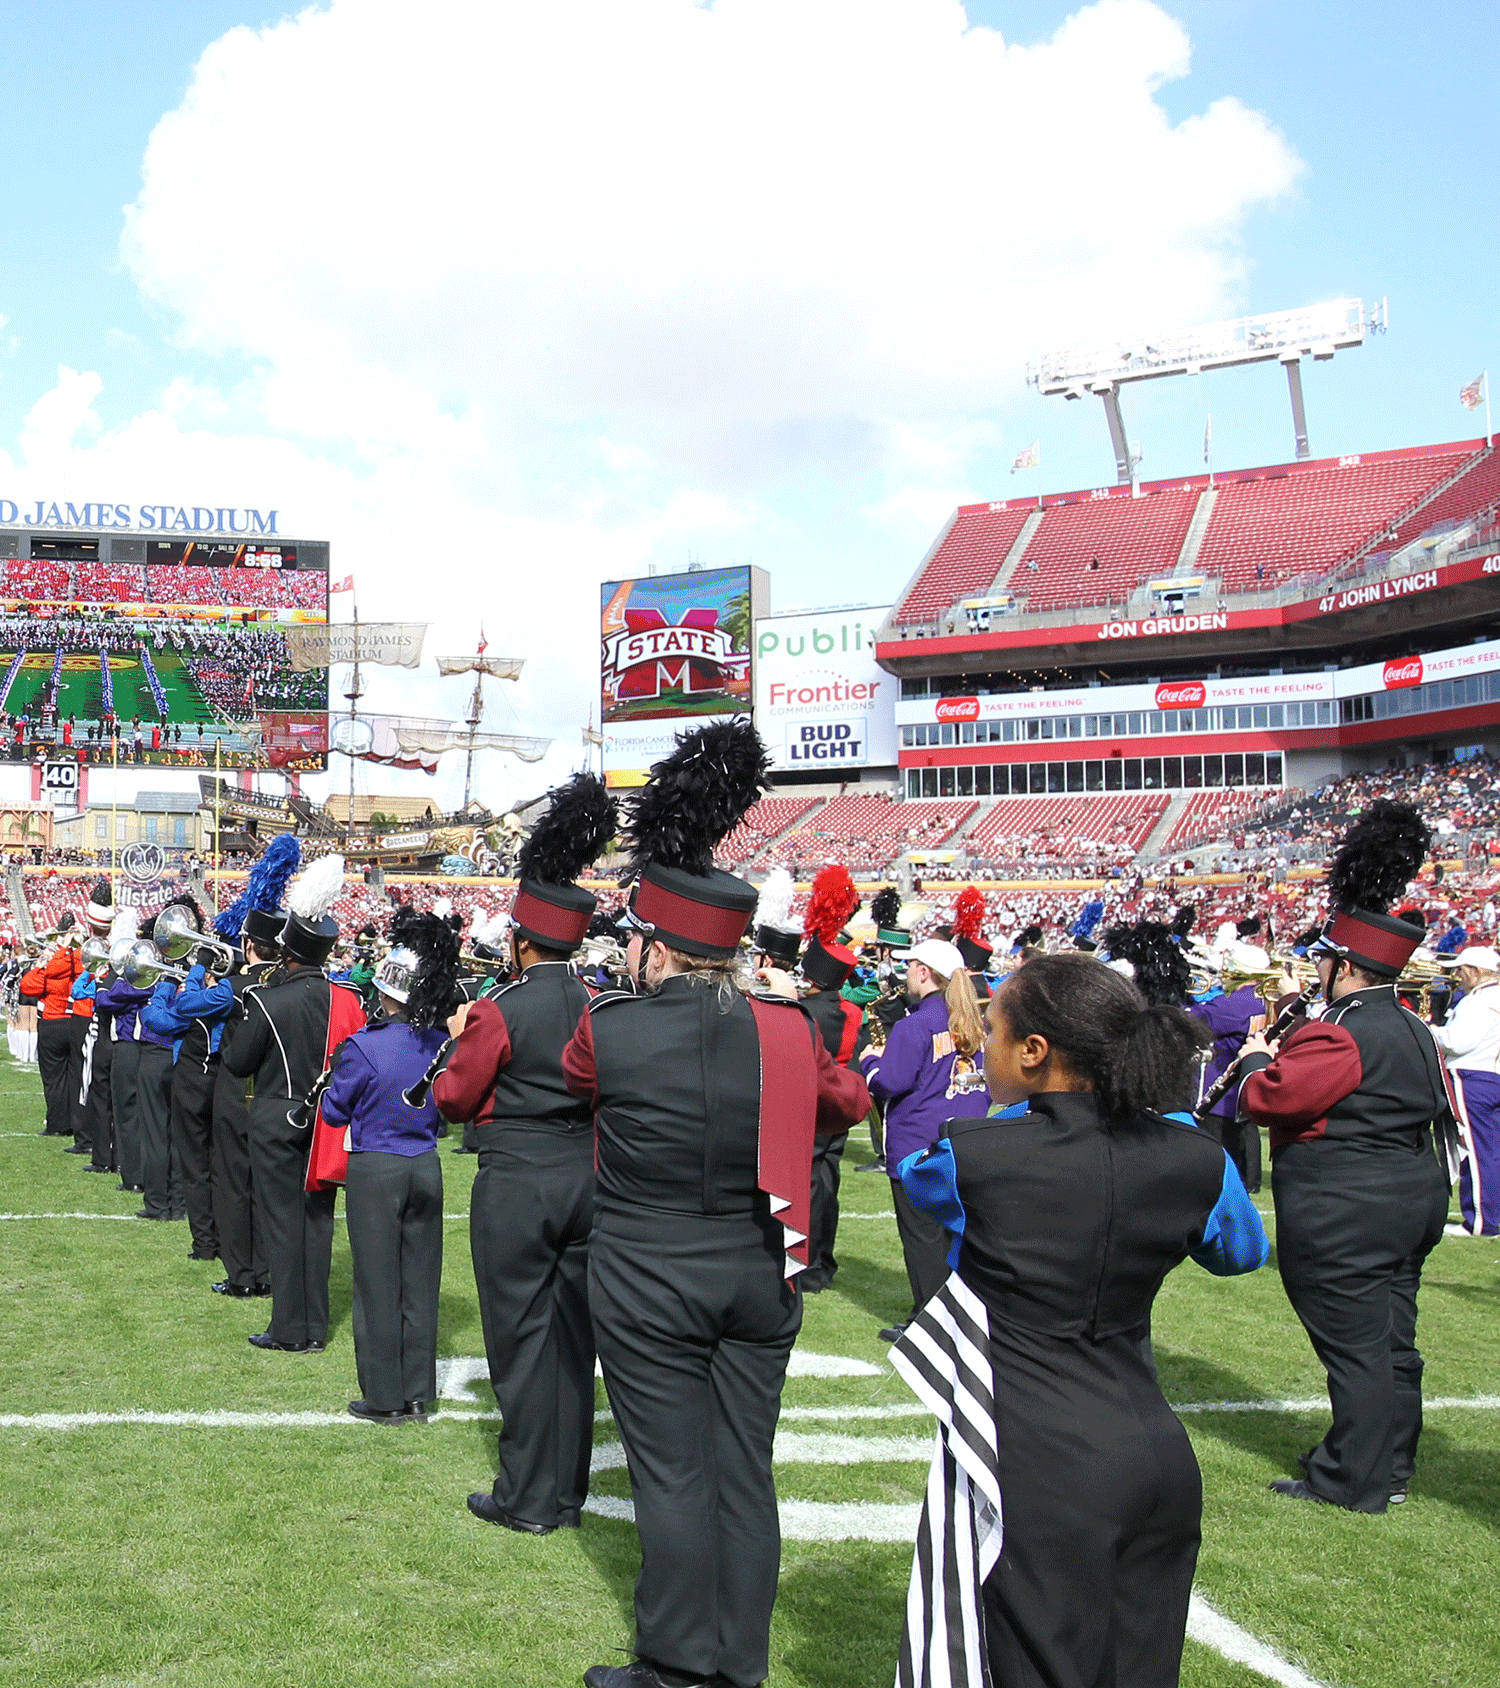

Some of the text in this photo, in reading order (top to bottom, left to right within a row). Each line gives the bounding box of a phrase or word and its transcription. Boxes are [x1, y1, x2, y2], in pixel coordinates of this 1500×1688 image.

[1338, 456, 1360, 467] 342
[1091, 488, 1109, 498] 343
[989, 501, 1007, 511] 344
[24, 501, 131, 528] JAMES
[139, 504, 279, 534] STADIUM
[245, 553, 282, 567] 8:58
[1319, 570, 1438, 612] 47 JOHN LYNCH
[1098, 613, 1227, 639] JON GRUDEN
[302, 635, 411, 648] RAYMOND JAMES
[628, 631, 716, 660] STATE
[330, 649, 381, 659] STADIUM
[1385, 662, 1420, 682] Coca-Cola
[1427, 660, 1454, 672] TASTE
[1457, 656, 1475, 667] THE
[770, 679, 880, 705] Frontier
[1157, 682, 1323, 703] Coca-Cola TASTE THE FEELING
[770, 701, 875, 716] COMMUNICATIONS
[937, 698, 1083, 717] Coca-Cola TASTE THE FEELING
[801, 724, 851, 742] BUD
[791, 741, 862, 760] LIGHT
[47, 766, 75, 785] 40
[386, 834, 426, 847] BUCCANEERS
